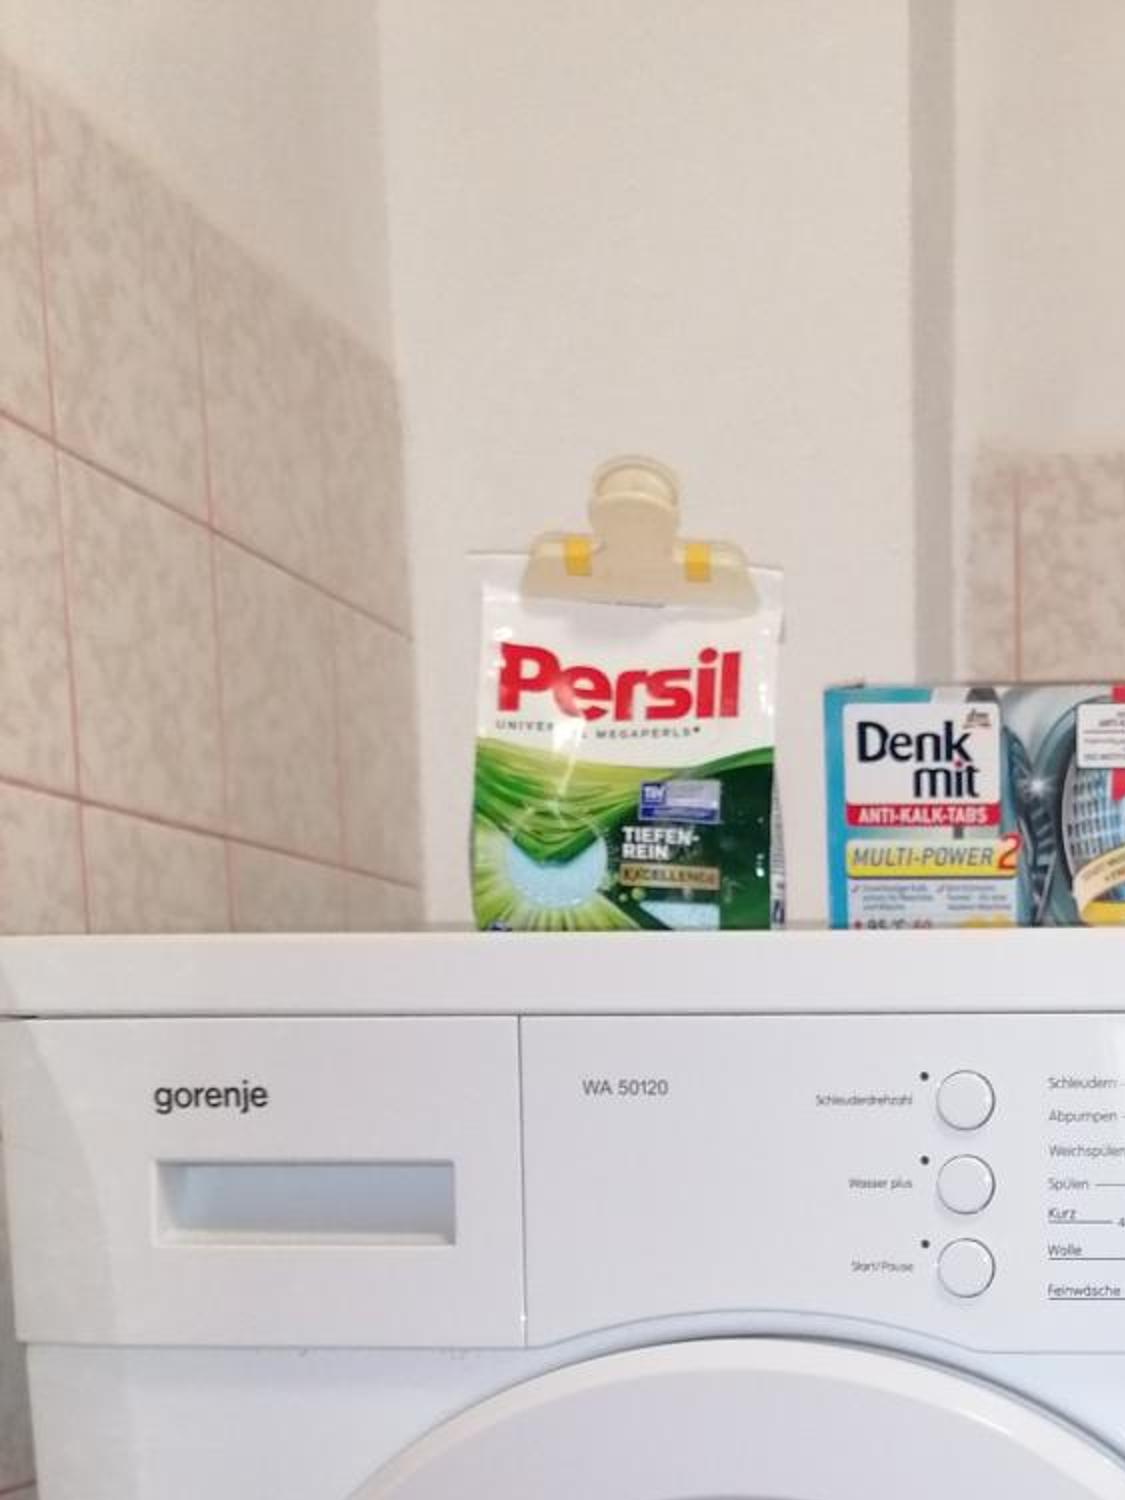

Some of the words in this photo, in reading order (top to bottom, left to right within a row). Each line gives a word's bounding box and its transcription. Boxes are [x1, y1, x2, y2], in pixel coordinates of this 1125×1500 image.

[497, 642, 741, 721] Persil
[857, 721, 973, 764] Denk
[914, 761, 980, 799] mit
[858, 804, 988, 825] ANTI-KALK-TABS
[621, 843, 671, 861] REIN
[582, 1079, 613, 1096] WA
[618, 1079, 669, 1096] 50120
[1048, 1077, 1118, 1089] Schleudern
[154, 1080, 269, 1114] gorenje
[816, 1093, 913, 1106] Schleuderdrehzahl
[1048, 1110, 1118, 1124] Abpumpen
[849, 1178, 888, 1189] Wasser
[890, 1177, 913, 1191] plus
[1048, 1177, 1089, 1192] Spülen
[1048, 1208, 1076, 1220] Kurz
[1048, 1245, 1082, 1257] Wolle
[851, 1260, 914, 1273] Start/Pause
[1048, 1284, 1121, 1297] Feinwäsche
